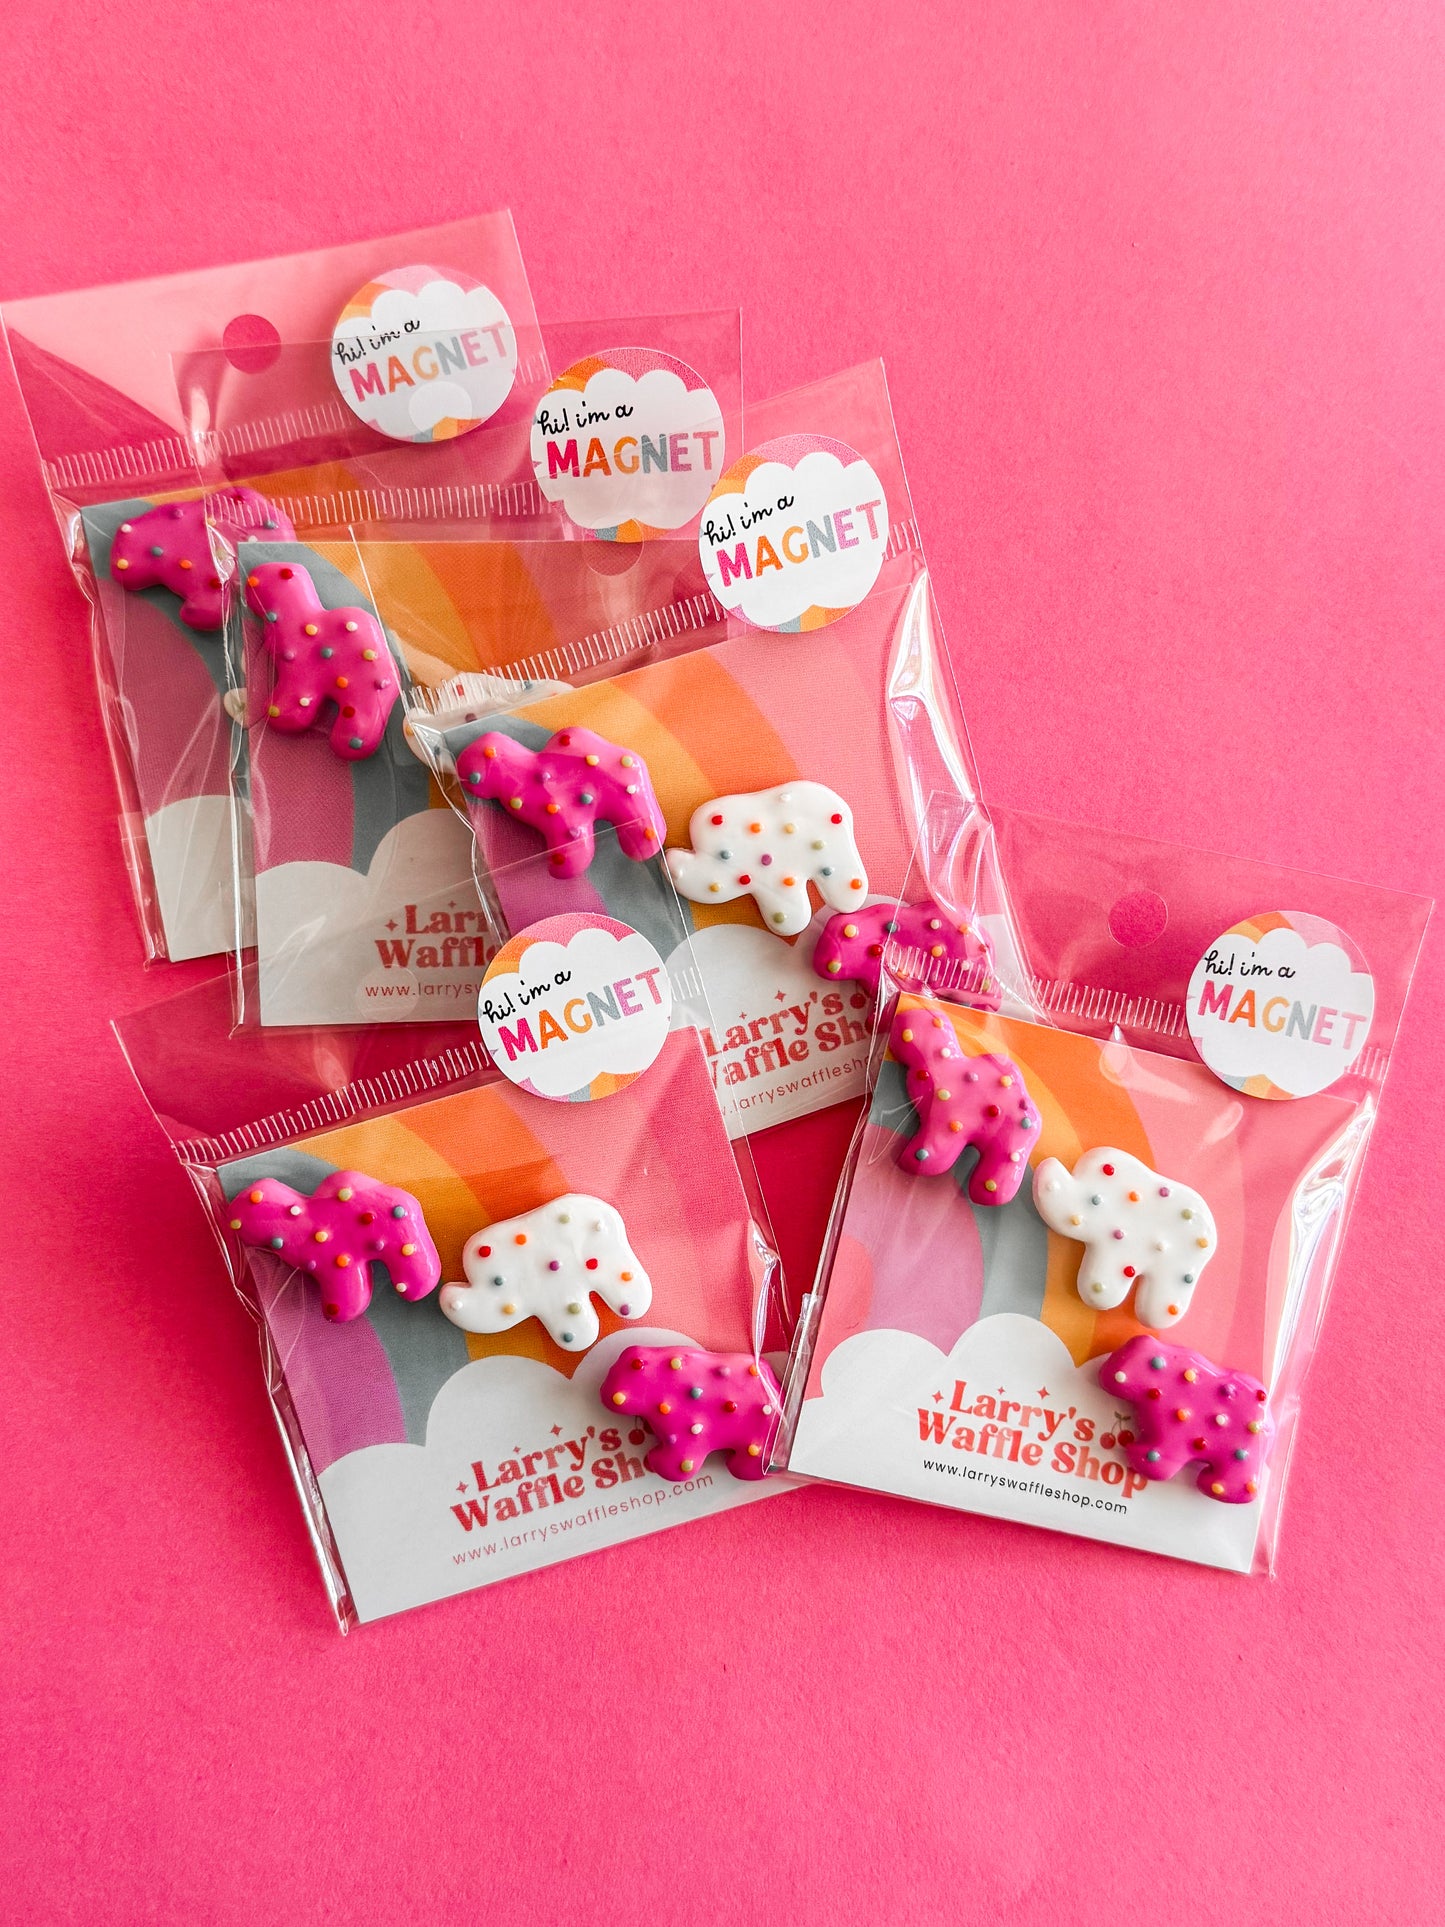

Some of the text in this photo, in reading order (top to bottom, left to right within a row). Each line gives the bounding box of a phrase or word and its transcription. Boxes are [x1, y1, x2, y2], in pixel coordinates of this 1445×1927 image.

[334, 336, 366, 365] hi!
[404, 320, 420, 333] a
[349, 321, 507, 402] MAGNET
[537, 400, 634, 435] hi! i'm a
[546, 430, 719, 479] MAGNET
[703, 495, 794, 546] hi! i'm a
[716, 499, 881, 588] MAGNET
[1204, 950, 1296, 979] hi! i'm a
[483, 970, 572, 1024] hi! i'm a
[497, 967, 662, 1062] MAGNET
[700, 991, 844, 1057] Larry's
[1197, 979, 1367, 1050] MAGNET
[814, 1015, 875, 1052] Sh
[949, 1379, 1096, 1442] Larry's
[470, 1425, 622, 1492] Larry's
[917, 1407, 1149, 1499] Waffle Shop
[450, 1451, 655, 1532] Waffle Sh
[923, 1458, 1128, 1515] www.larryswaffleshop.com
[452, 1474, 714, 1566] www.larryswaffleshop.com
